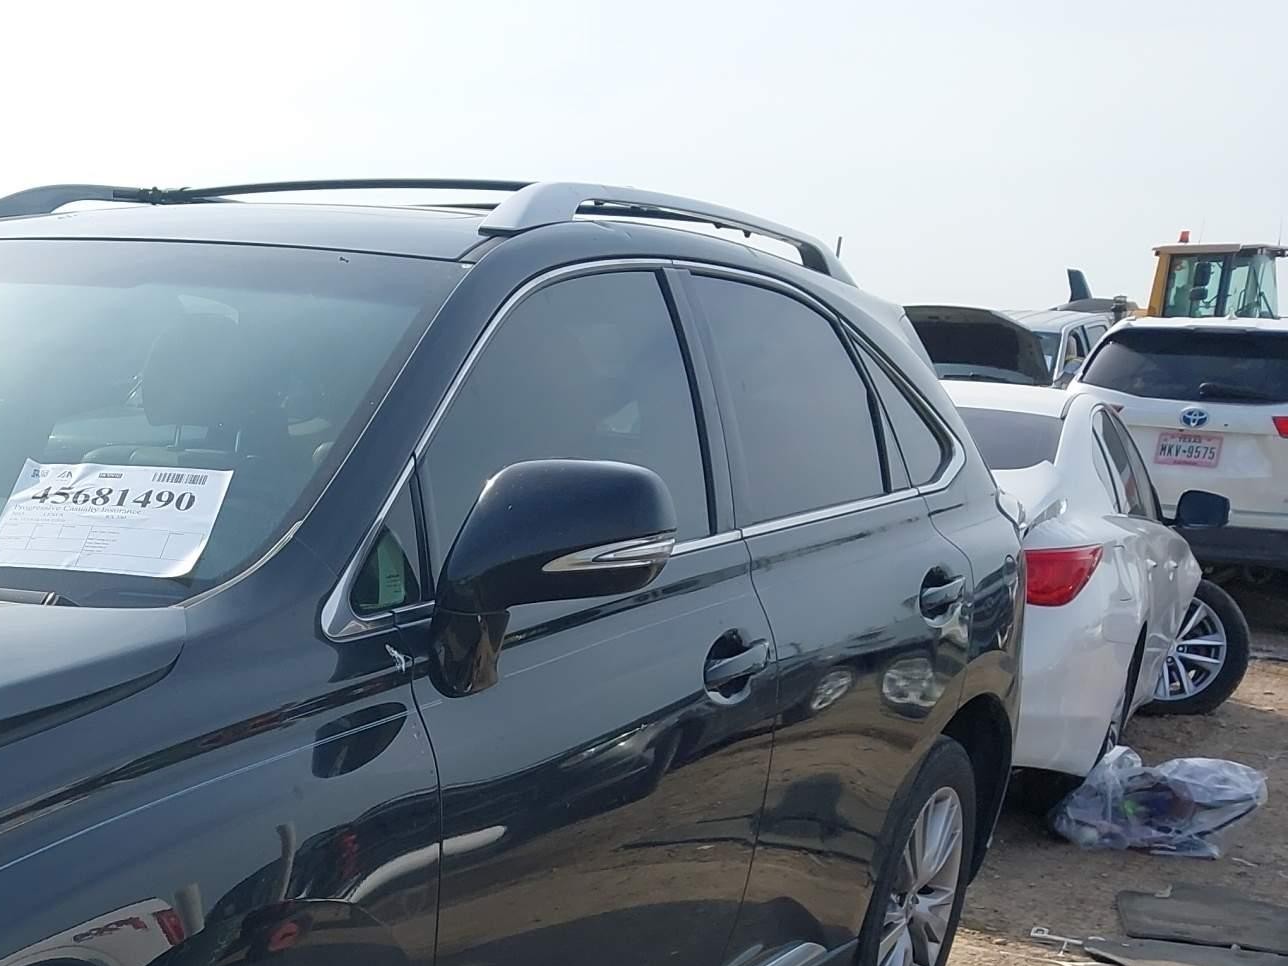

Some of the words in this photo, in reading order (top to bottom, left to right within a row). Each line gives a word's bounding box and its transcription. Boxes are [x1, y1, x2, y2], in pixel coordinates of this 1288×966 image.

[31, 486, 196, 511] 45681490
[63, 504, 99, 514] Casualty
[100, 506, 143, 515] Insurance
